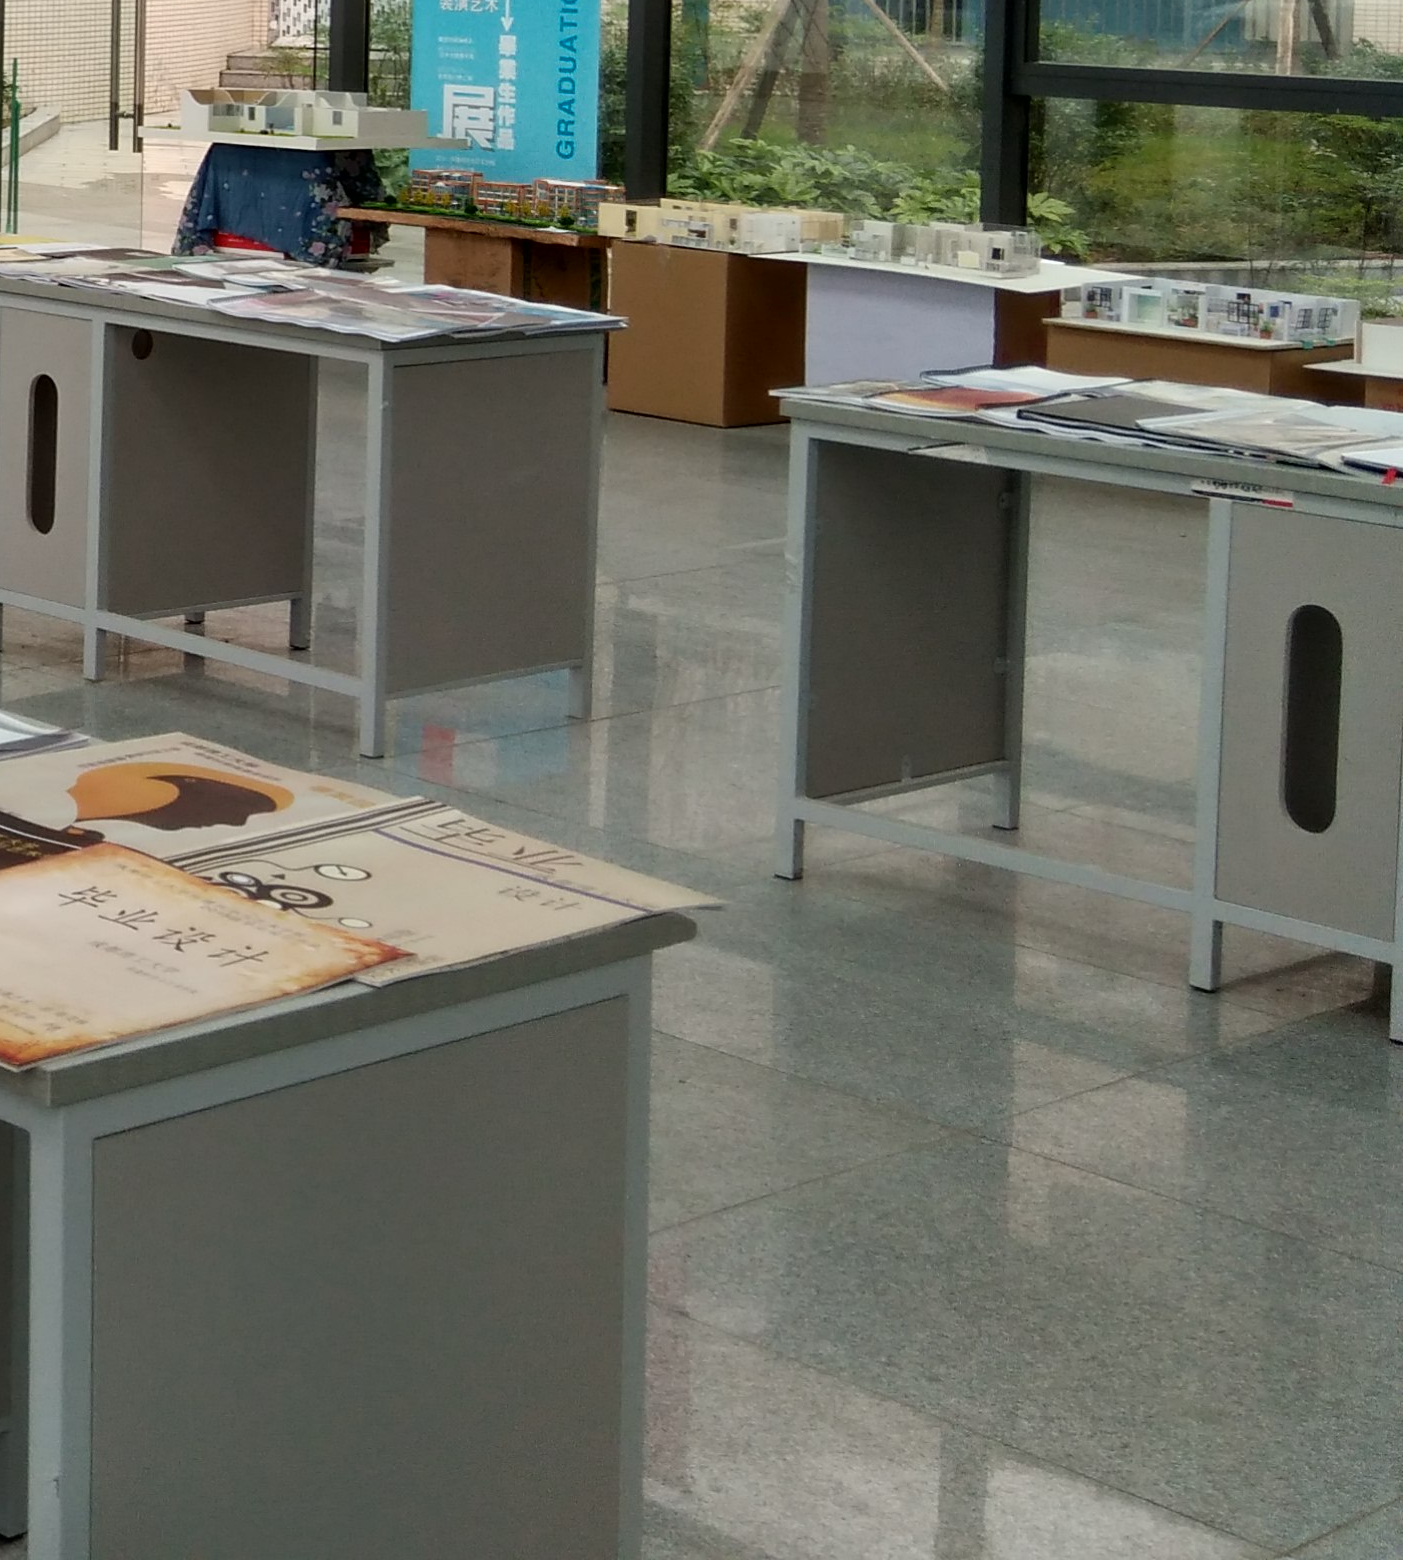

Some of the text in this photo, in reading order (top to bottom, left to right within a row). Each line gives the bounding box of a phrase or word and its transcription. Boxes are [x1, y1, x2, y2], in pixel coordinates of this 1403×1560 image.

[436, 84, 495, 151] 展
[57, 885, 270, 968] 毕业设计
